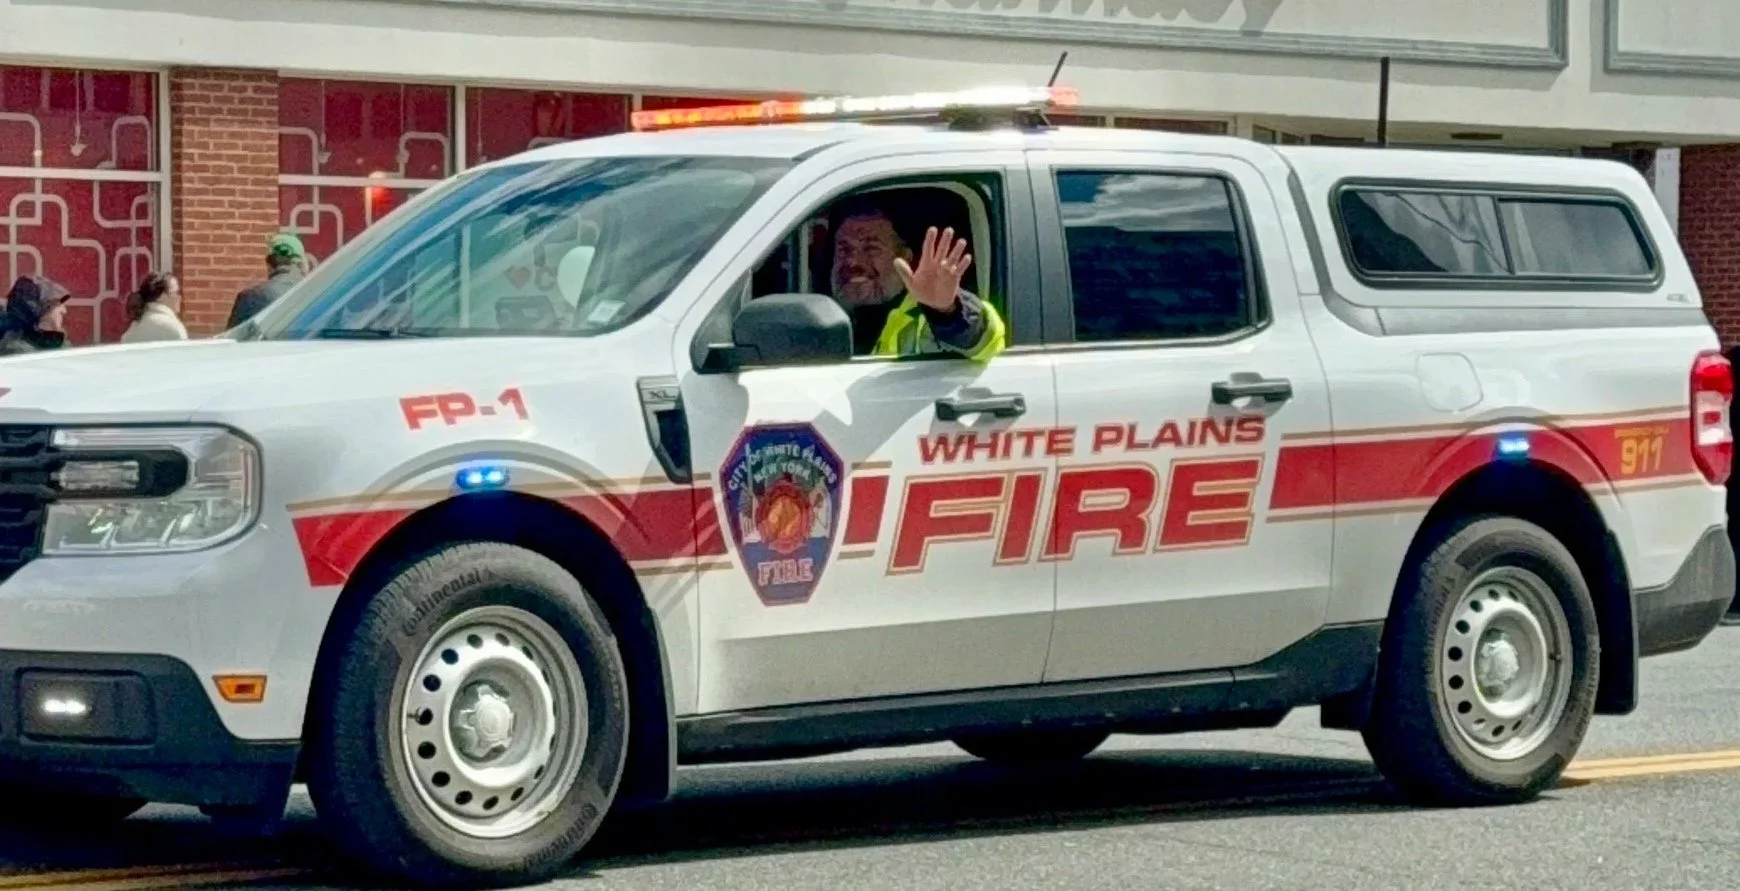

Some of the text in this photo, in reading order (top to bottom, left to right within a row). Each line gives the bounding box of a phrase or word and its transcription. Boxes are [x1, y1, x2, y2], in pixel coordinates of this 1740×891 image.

[399, 388, 529, 431] FP-1
[918, 415, 1267, 465] WHITE PLAINS
[1621, 435, 1663, 475] 911
[728, 461, 749, 491] CITY
[763, 443, 801, 459] WHITE
[802, 444, 838, 484] PLAINS
[753, 462, 813, 484] NEW YORK
[886, 453, 1266, 576] FIRE
[757, 557, 814, 587] FIRE
[401, 567, 482, 637] Continental
